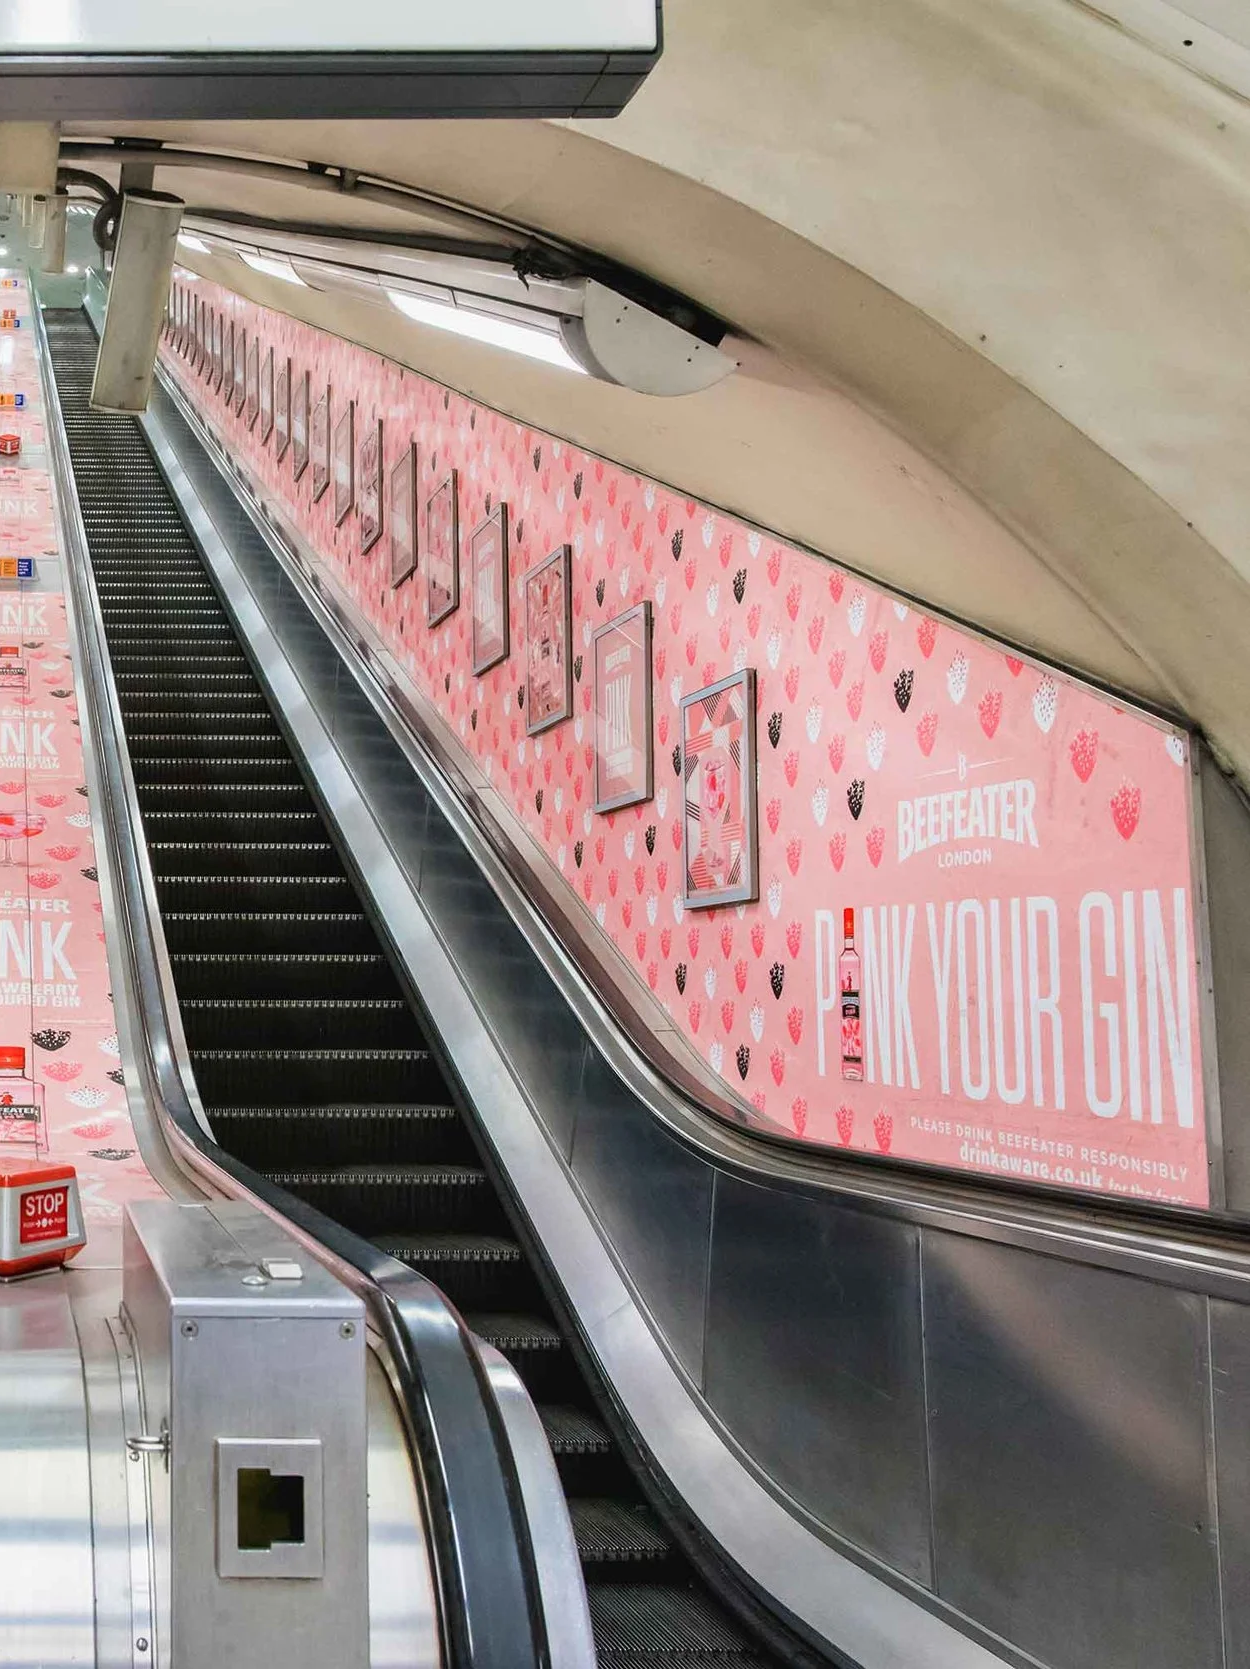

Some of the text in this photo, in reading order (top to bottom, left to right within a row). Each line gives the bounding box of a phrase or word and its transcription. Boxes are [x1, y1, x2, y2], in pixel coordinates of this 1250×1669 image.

[898, 779, 1039, 863] BEEFEATER
[937, 848, 992, 868] LONDON
[51, 995, 82, 1008] GIN
[926, 896, 1066, 1110] YOUR
[1078, 887, 1194, 1128] GIN
[910, 1115, 1188, 1183] PLEASE DRINK BEEFEATER RESPONSIBLY
[959, 1141, 1103, 1188] drinkaware.co.uk
[25, 1192, 64, 1216] STOP
